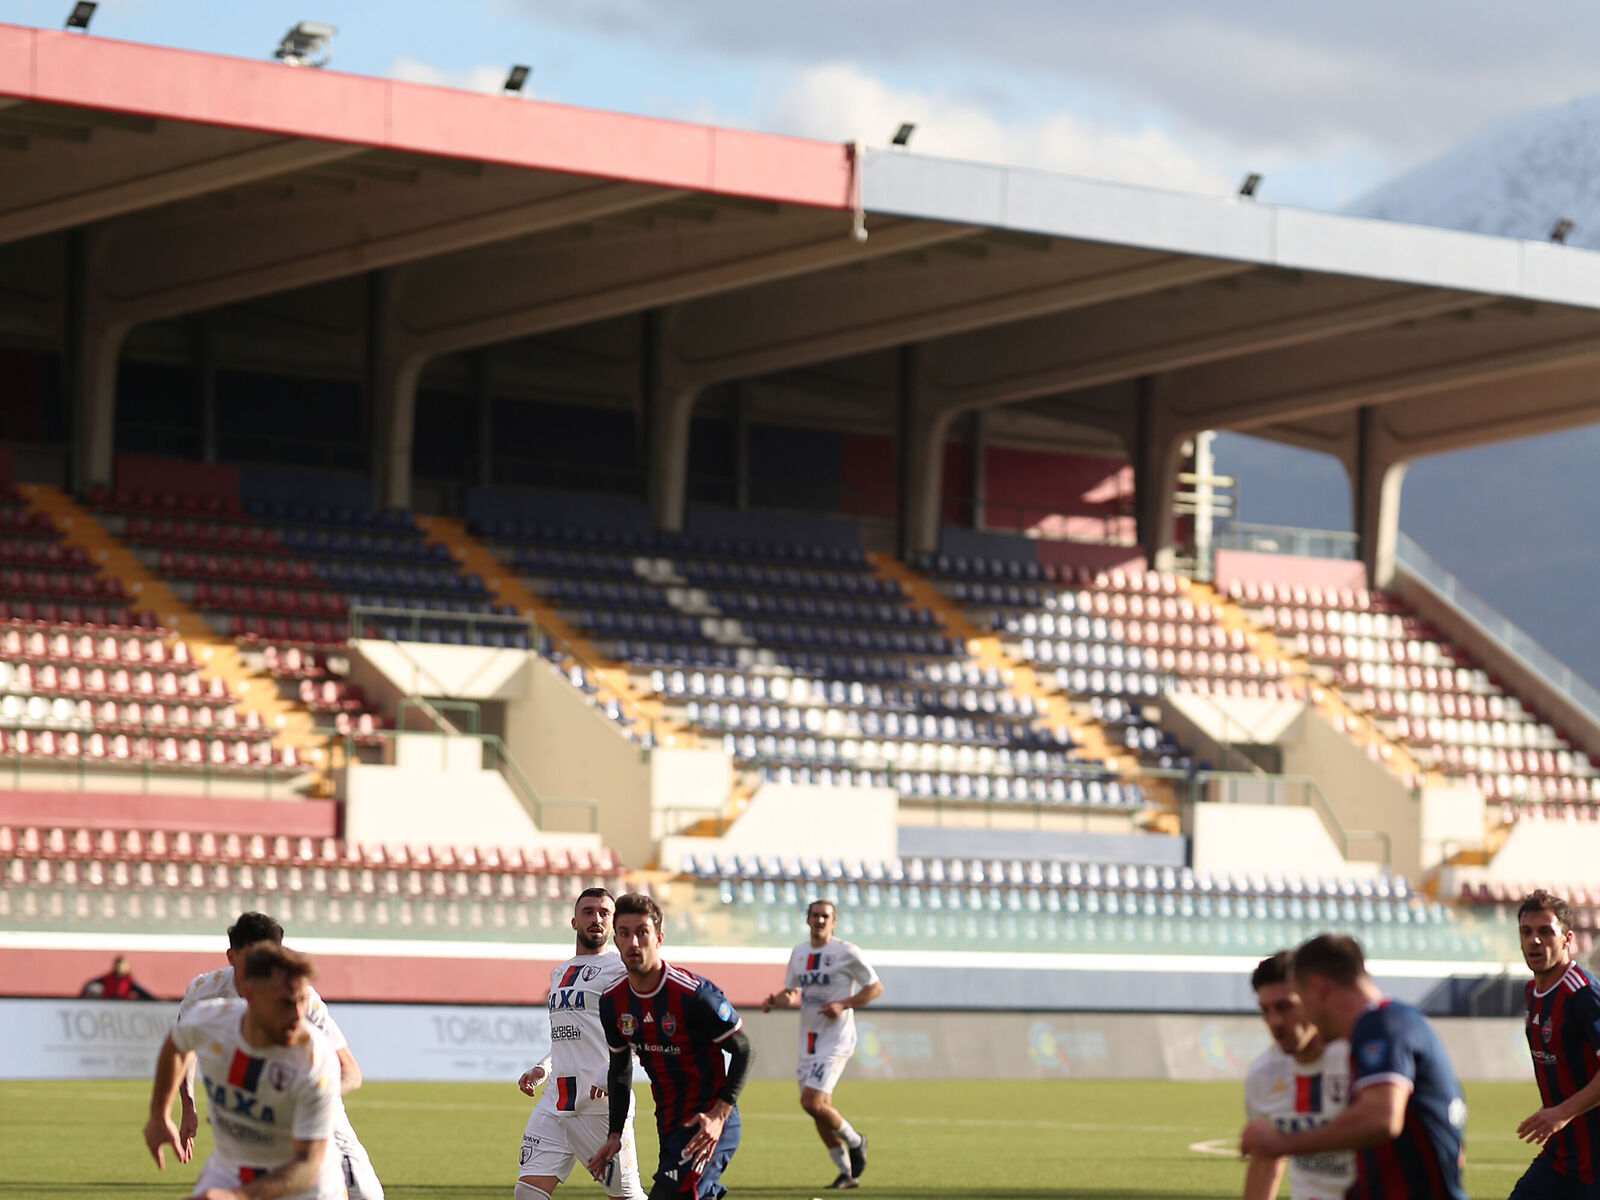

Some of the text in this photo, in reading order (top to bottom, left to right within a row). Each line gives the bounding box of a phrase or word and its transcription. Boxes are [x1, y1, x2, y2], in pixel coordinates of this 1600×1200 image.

[797, 971, 830, 986] AXA
[549, 989, 586, 1010] AXA
[57, 1008, 173, 1042] TORLON
[431, 1014, 548, 1045] TORLON
[551, 1025, 574, 1033] IUDICI
[203, 1075, 276, 1125] AXA
